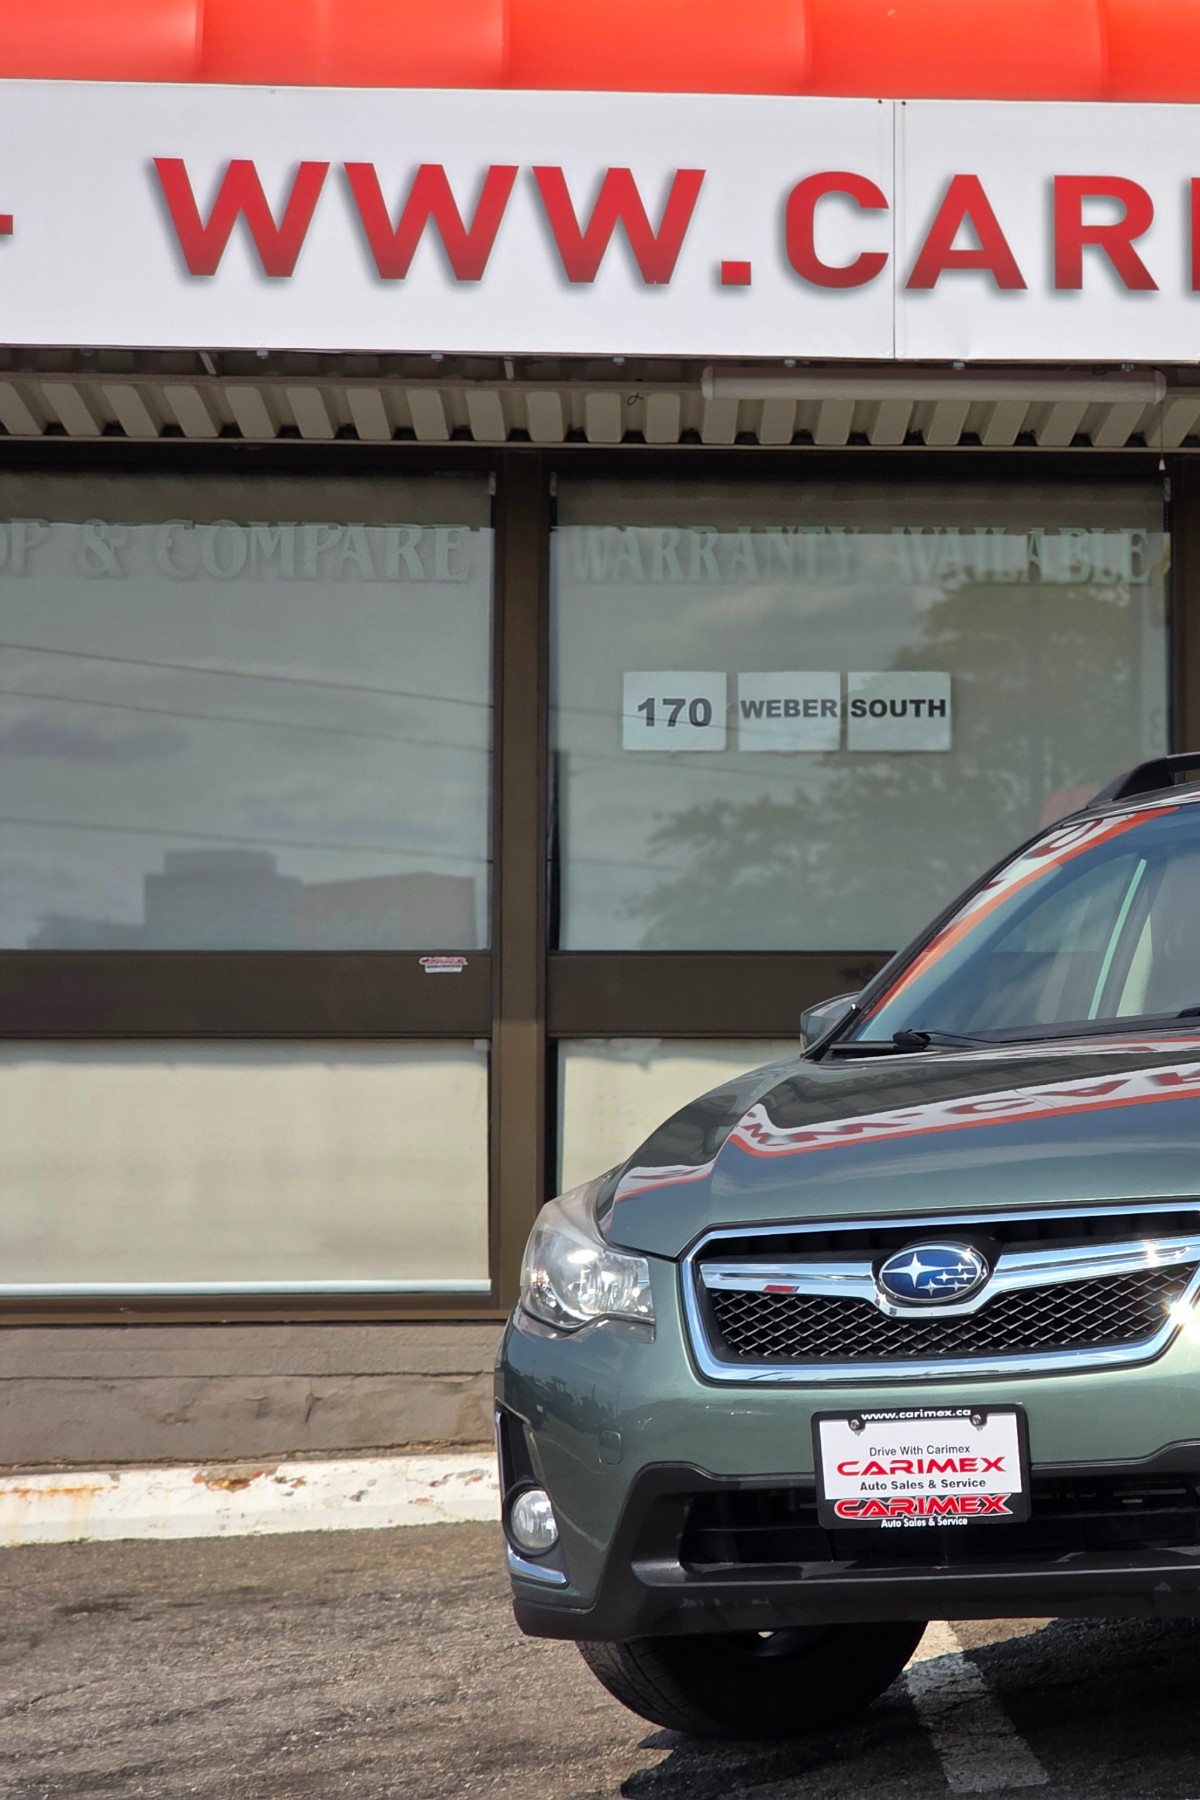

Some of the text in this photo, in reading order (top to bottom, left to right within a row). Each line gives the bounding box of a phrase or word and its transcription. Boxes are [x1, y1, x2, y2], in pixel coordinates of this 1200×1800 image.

[78, 518, 127, 579] &
[153, 519, 471, 583] COMPARE
[568, 525, 1149, 585] WARRANTY AVAILABLE
[637, 696, 947, 728] 170 WEBER SOUTH
[860, 1408, 972, 1421] www.carimex.ca
[869, 1444, 971, 1457] Drive With Carimex
[836, 1456, 1007, 1477] CARIMEX
[860, 1478, 987, 1492] Auto Sales & Service
[835, 1494, 1012, 1519] CARIMEX
[880, 1516, 968, 1529] Auto Sales & Service
